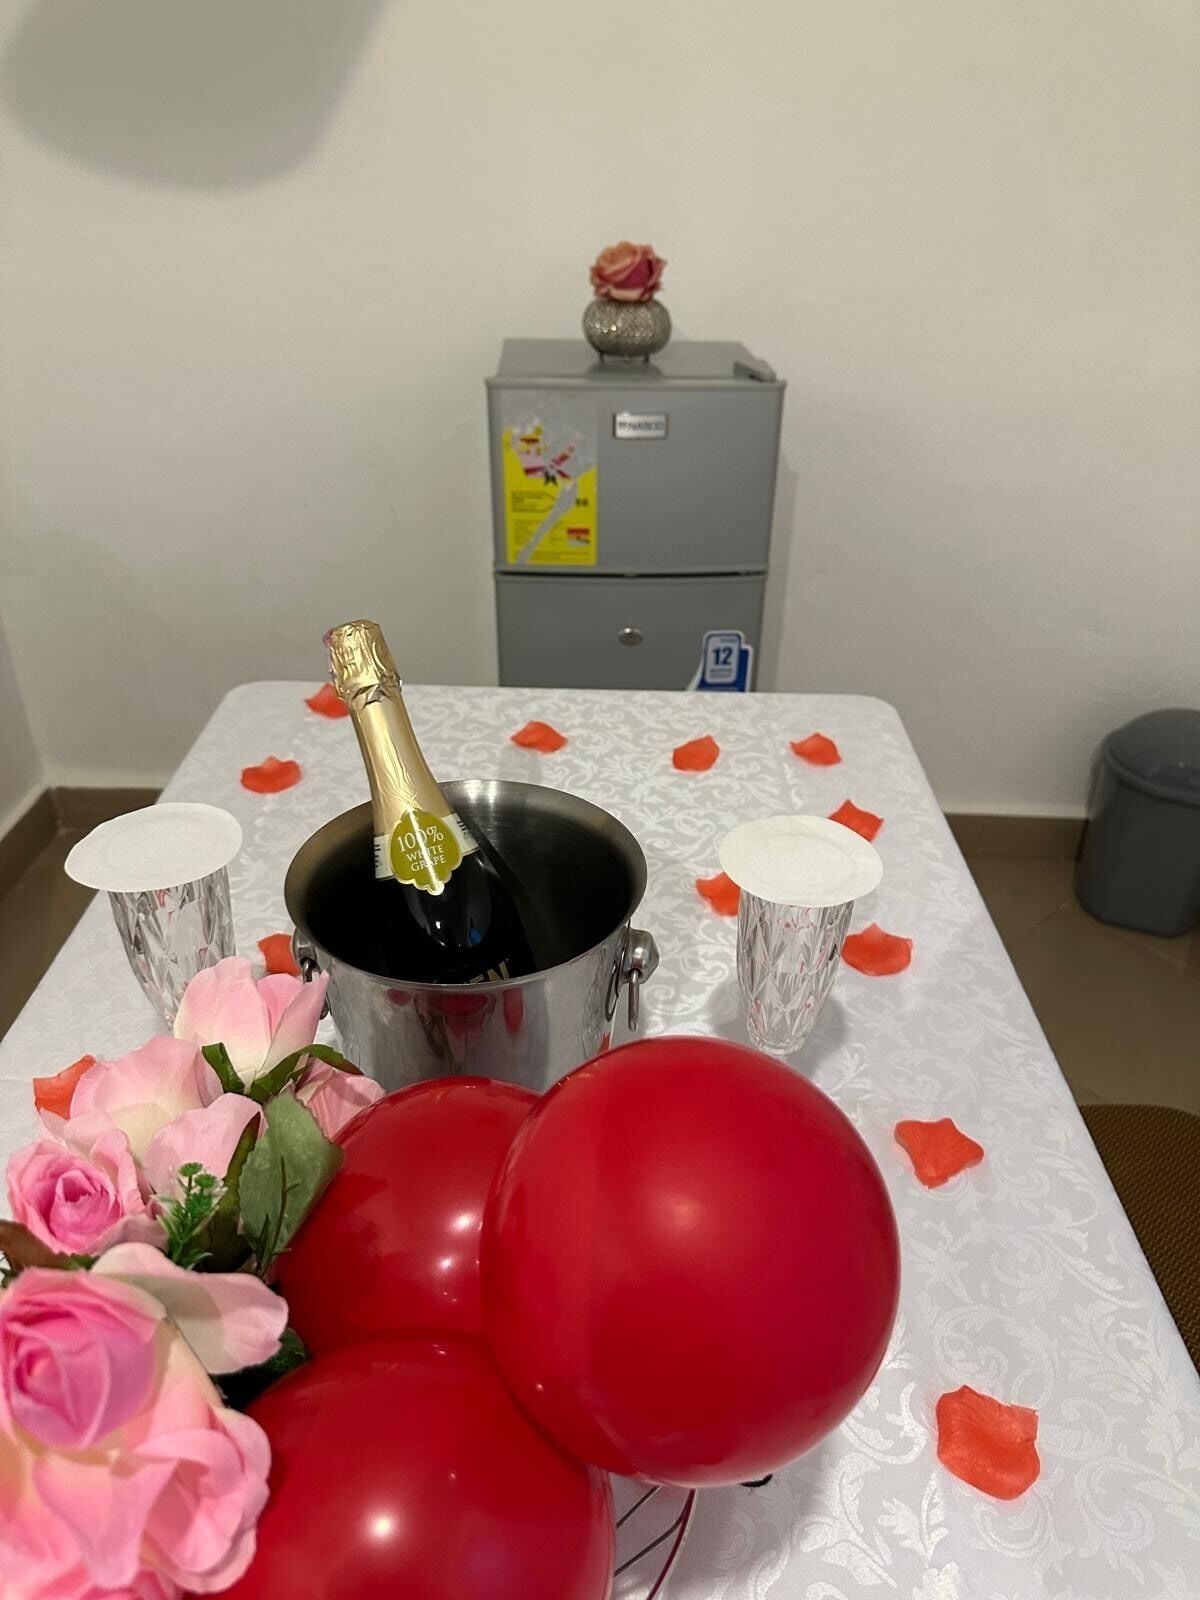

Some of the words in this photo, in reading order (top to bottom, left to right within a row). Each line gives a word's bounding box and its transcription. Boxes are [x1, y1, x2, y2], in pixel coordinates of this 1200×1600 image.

[713, 647, 733, 666] 12
[397, 825, 444, 852] 100%
[406, 844, 444, 862] WHITE
[411, 854, 447, 872] GRAPE
